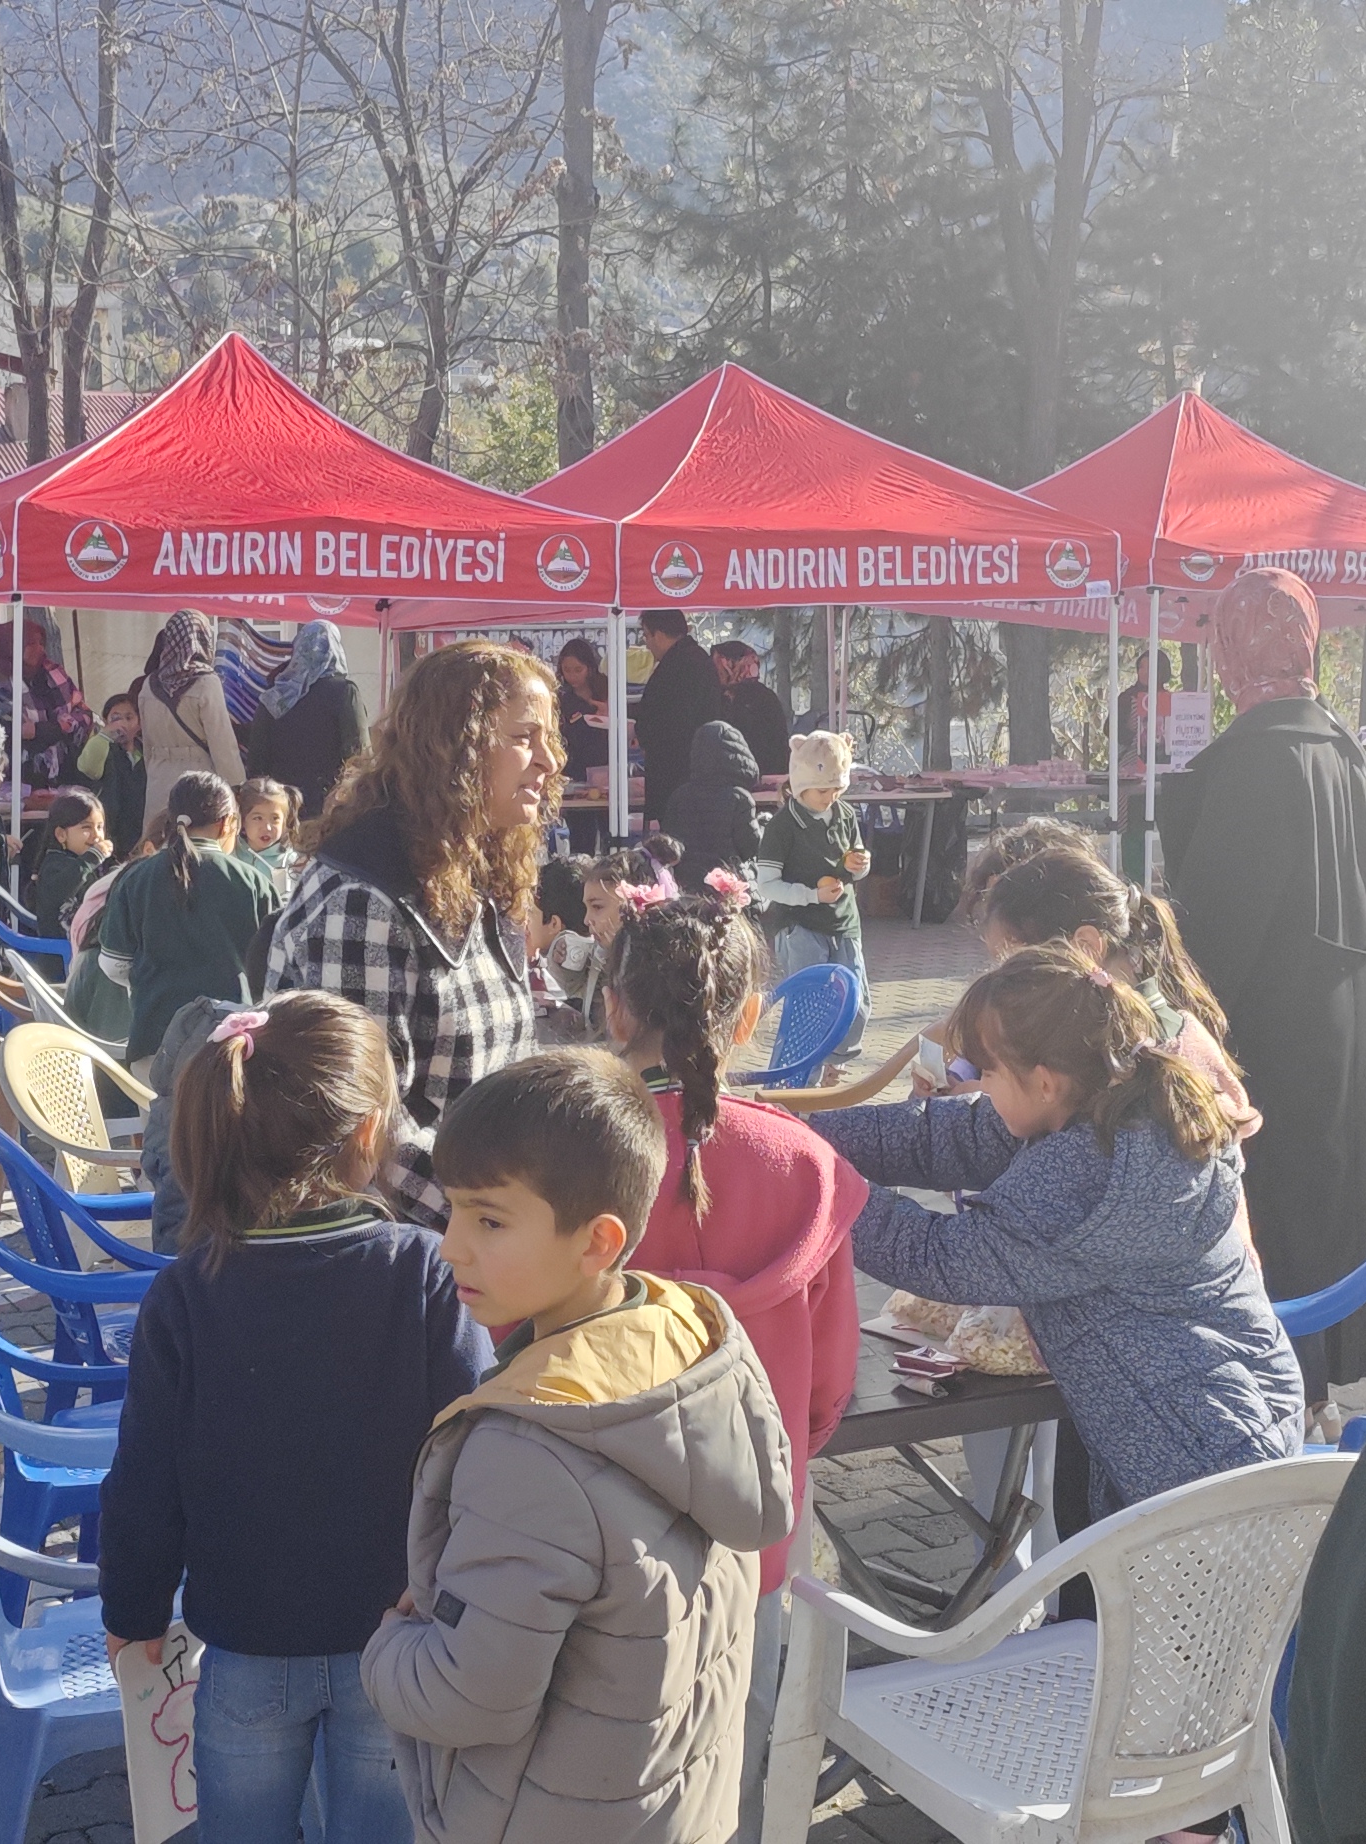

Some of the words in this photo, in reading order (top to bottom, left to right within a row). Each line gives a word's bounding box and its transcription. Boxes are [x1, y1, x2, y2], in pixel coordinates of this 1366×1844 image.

[152, 531, 303, 577] ANDIRIN
[315, 530, 505, 583] BELEDİYESİ
[724, 547, 847, 590] ANDIRIN
[857, 537, 1019, 587] BELEDİYESİ
